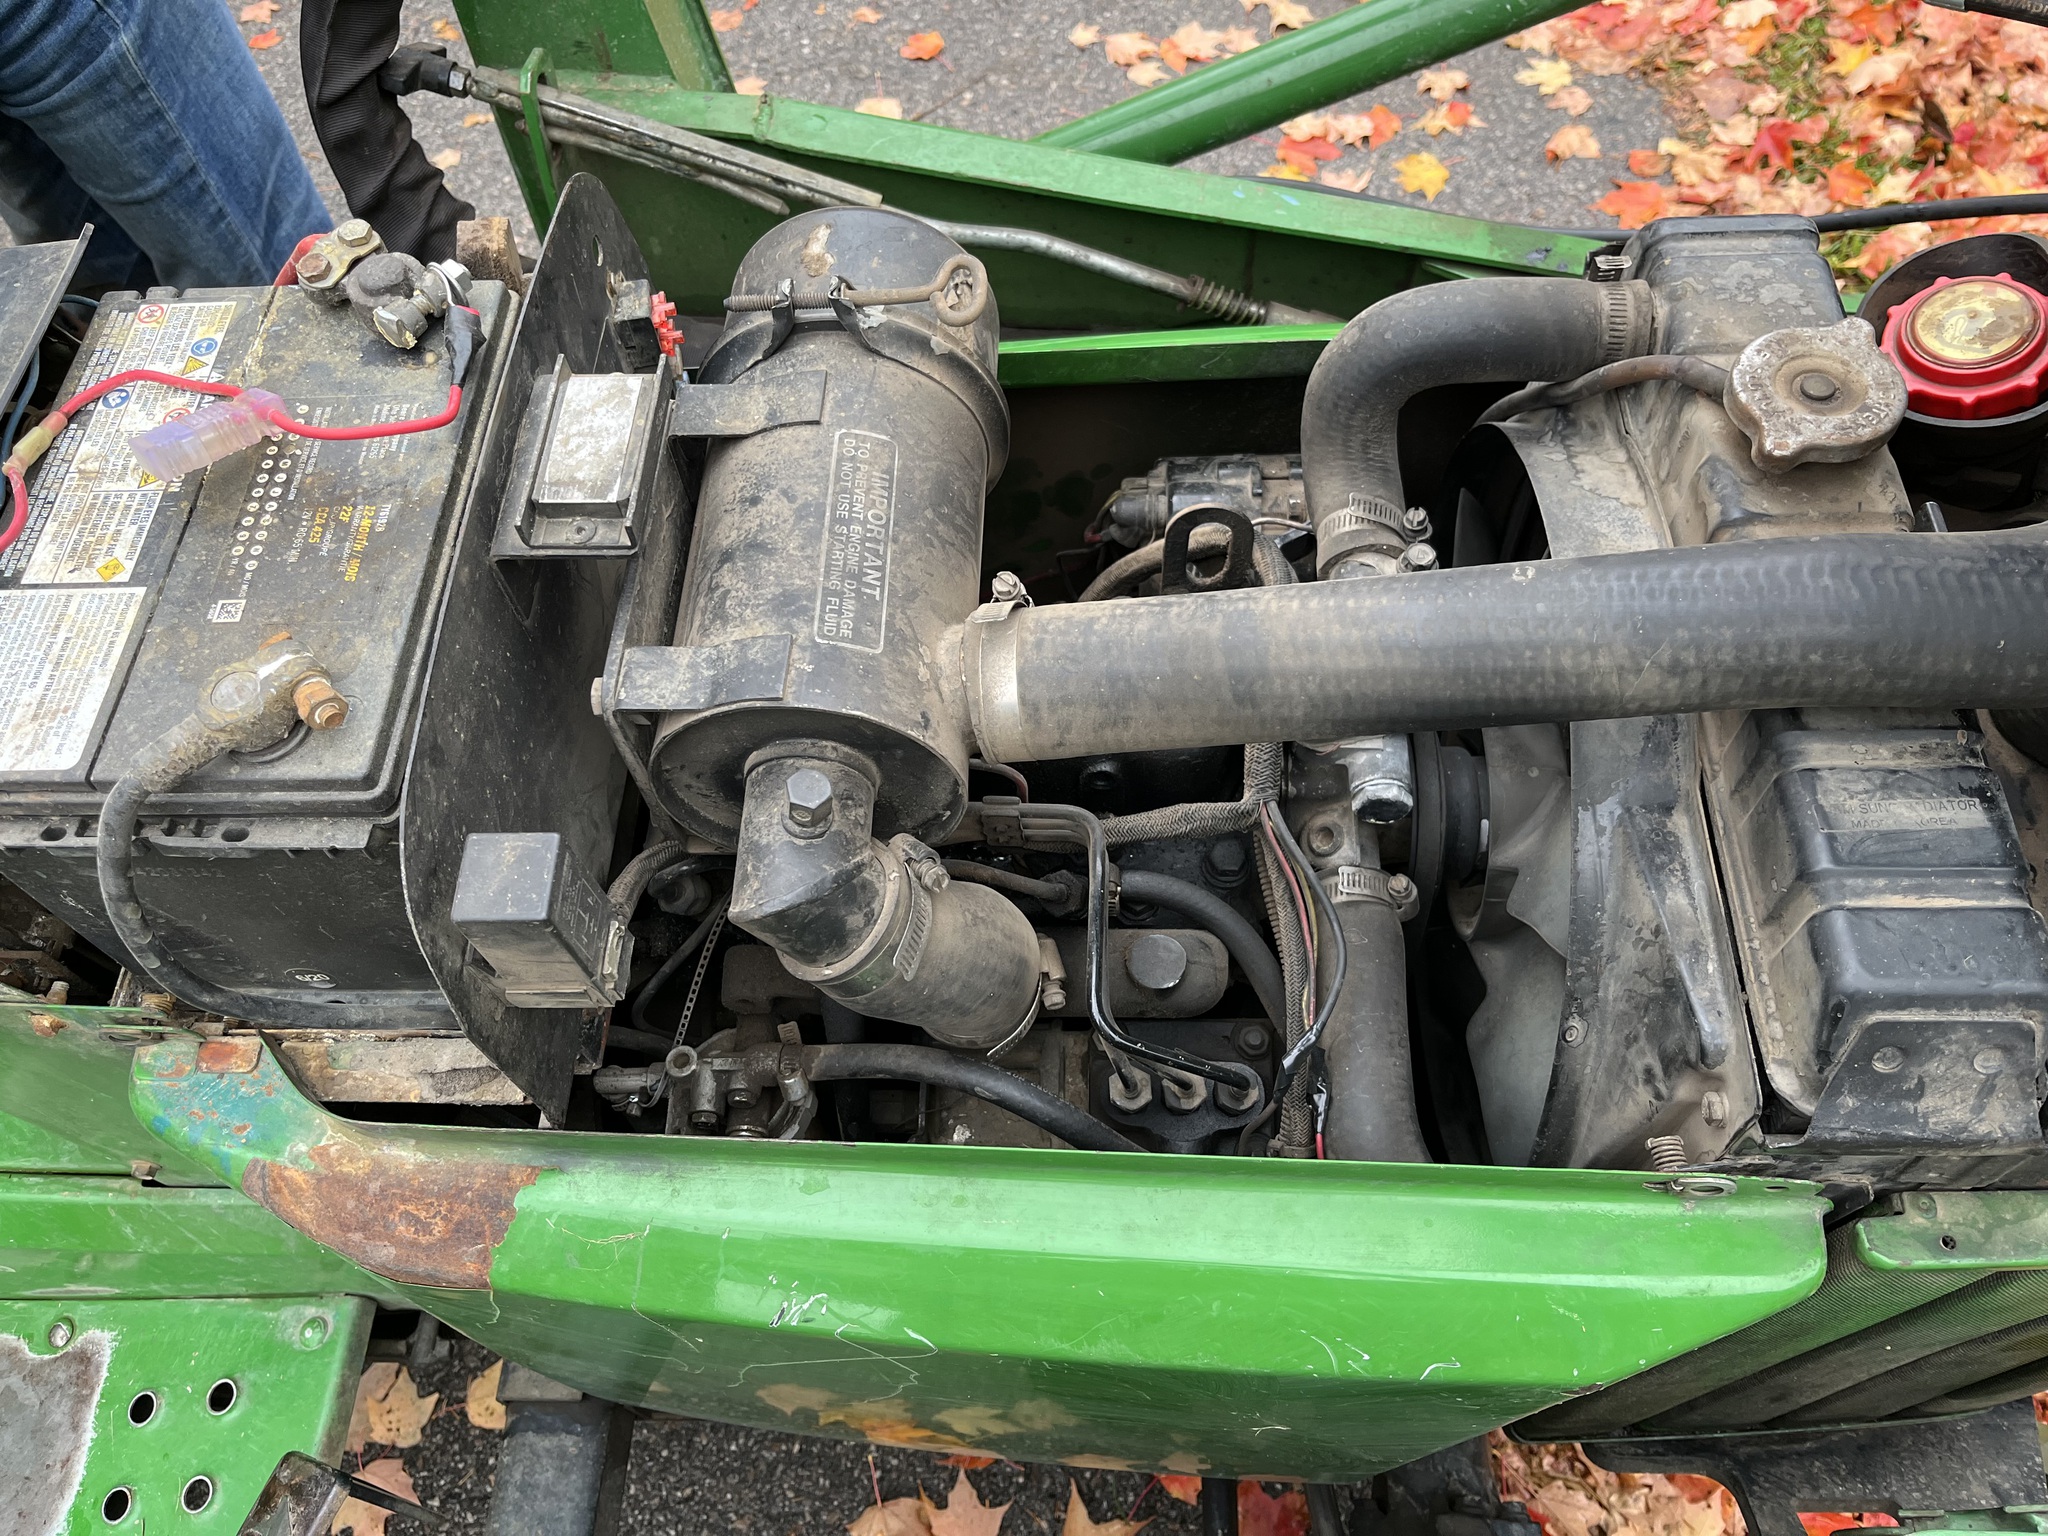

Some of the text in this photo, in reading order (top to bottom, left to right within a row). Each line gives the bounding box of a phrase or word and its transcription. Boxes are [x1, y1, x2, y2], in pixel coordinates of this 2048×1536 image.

[368, 442, 380, 458] 61265
[115, 504, 132, 527] MEDICAL
[127, 492, 149, 527] WITH WATER.
[337, 505, 353, 522] 22F
[109, 528, 123, 542] HELP
[123, 492, 159, 560] FLUSH EYES IMMEDIATELY
[307, 507, 329, 543] CCA 425
[861, 470, 889, 601] IMPORTANT
[93, 532, 108, 546] YEUX
[824, 438, 856, 636] DO NOT USE STARTING FLUID
[839, 442, 871, 639] TO PREVENT ENGINE DAMAGE
[102, 543, 117, 558] FAST.
[343, 557, 361, 581] MOIS
[113, 592, 135, 630] PROPOSITION
[58, 636, 71, 652] WASH
[31, 641, 54, 679] PROPOSITION
[42, 673, 57, 692] AFTER
[295, 974, 330, 982] 6/20
